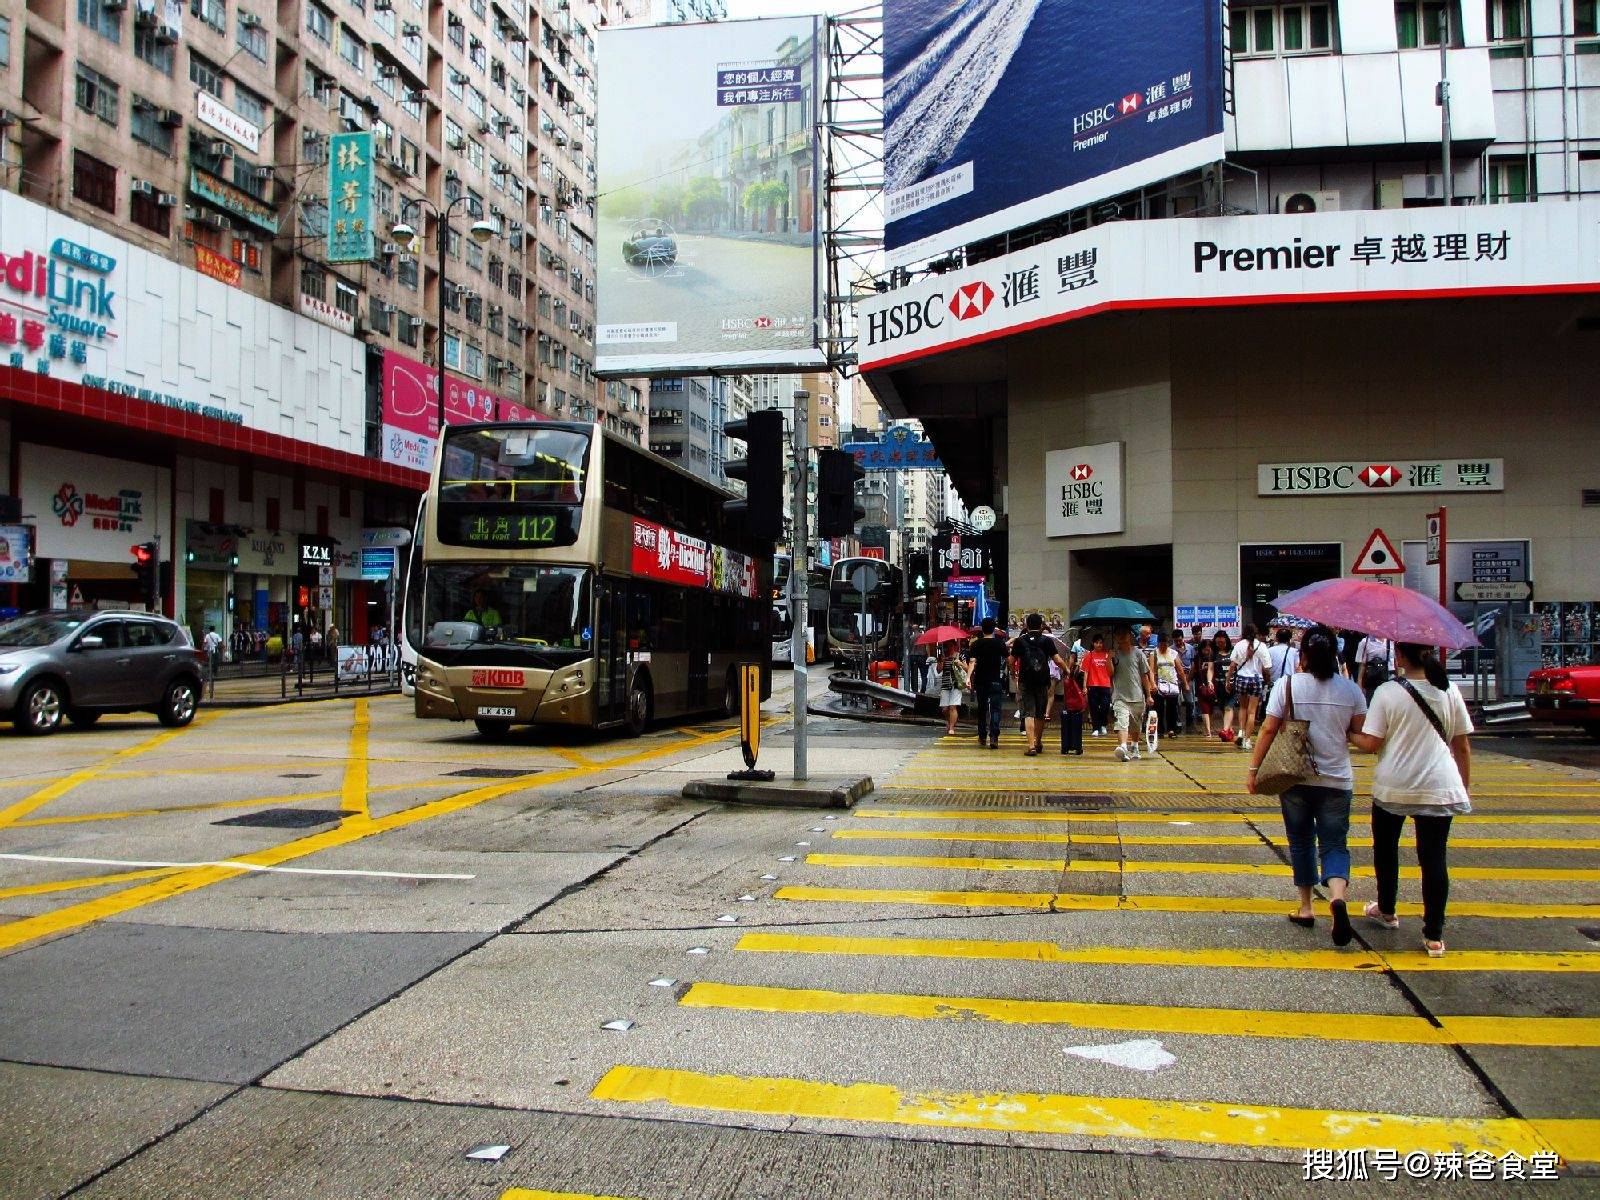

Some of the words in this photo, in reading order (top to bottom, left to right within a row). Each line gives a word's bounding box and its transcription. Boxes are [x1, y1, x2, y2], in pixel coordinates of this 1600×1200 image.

[723, 69, 795, 85] 您的個人經濟
[723, 87, 795, 104] 我們專注所在
[1073, 102, 1115, 135] HSBC
[1147, 97, 1193, 123] 卓越理財
[1073, 131, 1109, 153] Premier
[1194, 237, 1341, 273] Premier
[1349, 230, 1511, 267] 卓越理財
[48, 304, 107, 340] Square
[721, 318, 752, 330] HSBC
[867, 293, 945, 346] HSBC
[81, 373, 107, 389] ONE
[108, 380, 137, 398] STOP
[1061, 481, 1103, 500] HSBC
[1271, 465, 1355, 491] HSBC
[473, 516, 508, 534] 北角
[518, 516, 556, 541] 112
[302, 545, 331, 560] KZM
